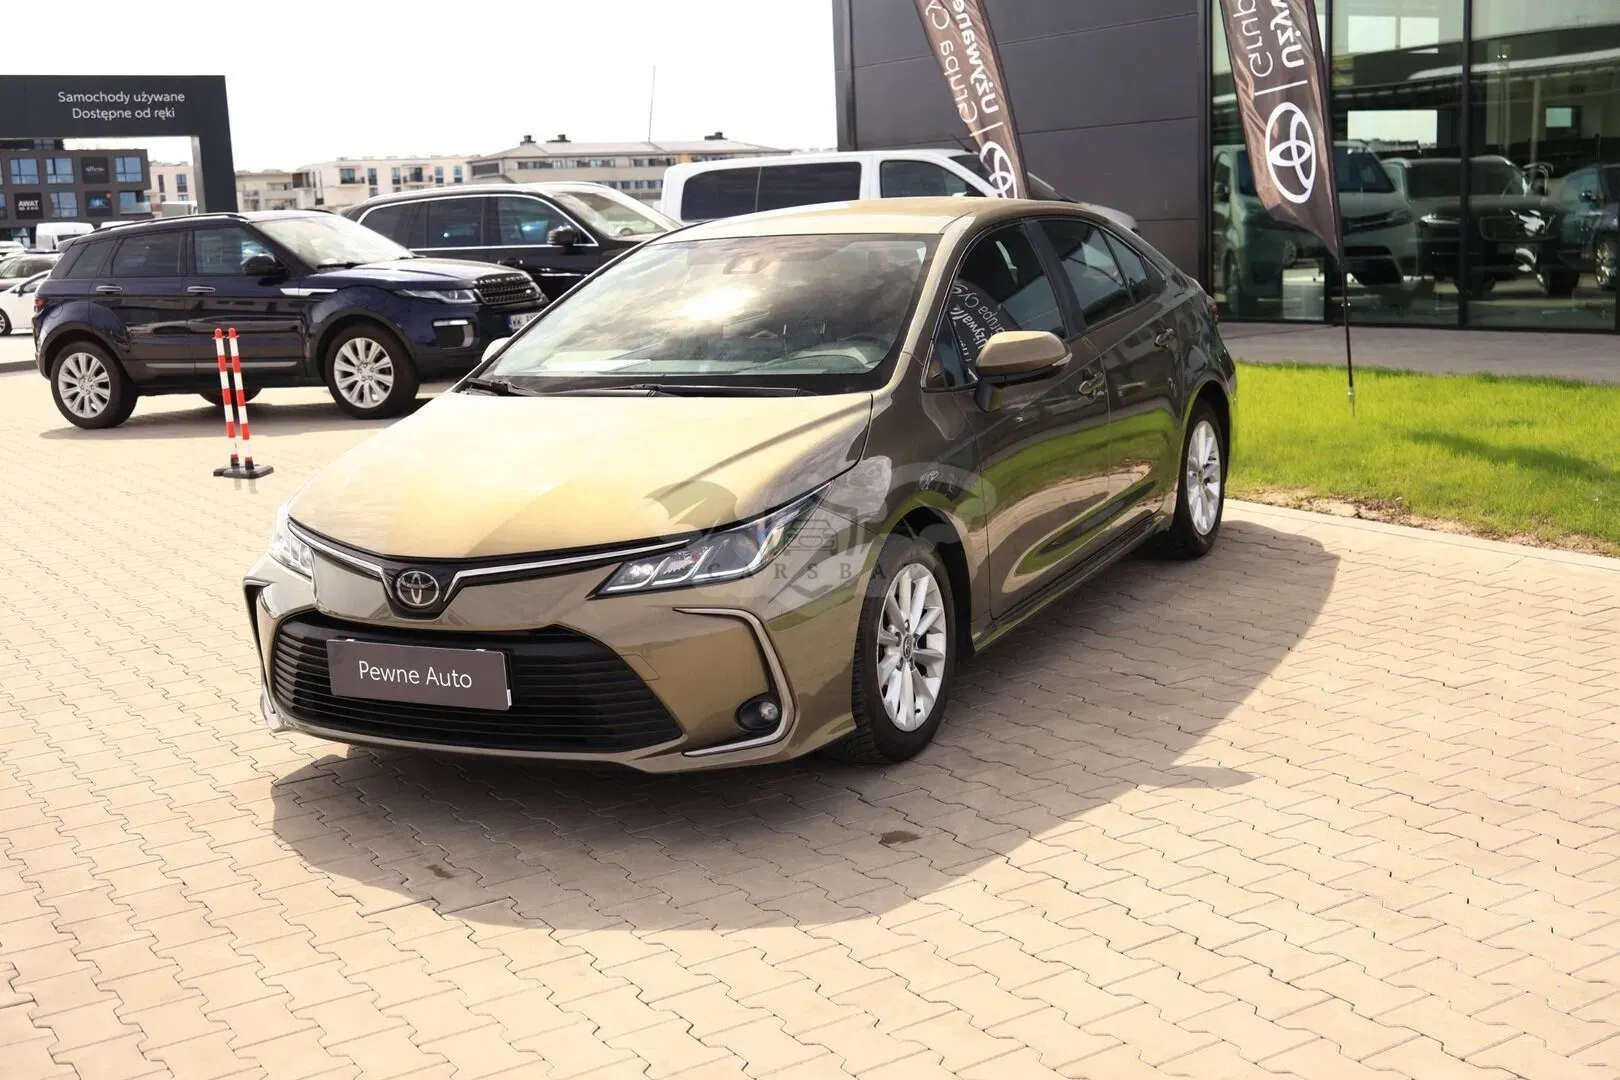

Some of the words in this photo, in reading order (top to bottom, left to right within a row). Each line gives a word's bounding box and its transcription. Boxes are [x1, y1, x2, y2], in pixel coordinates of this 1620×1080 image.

[57, 91, 131, 104] Samochody
[133, 91, 185, 104] używane
[72, 107, 132, 120] Dostępne
[134, 107, 151, 118] od
[154, 107, 175, 120] ręki
[358, 660, 420, 684] Pewne
[425, 666, 473, 688] Auto
